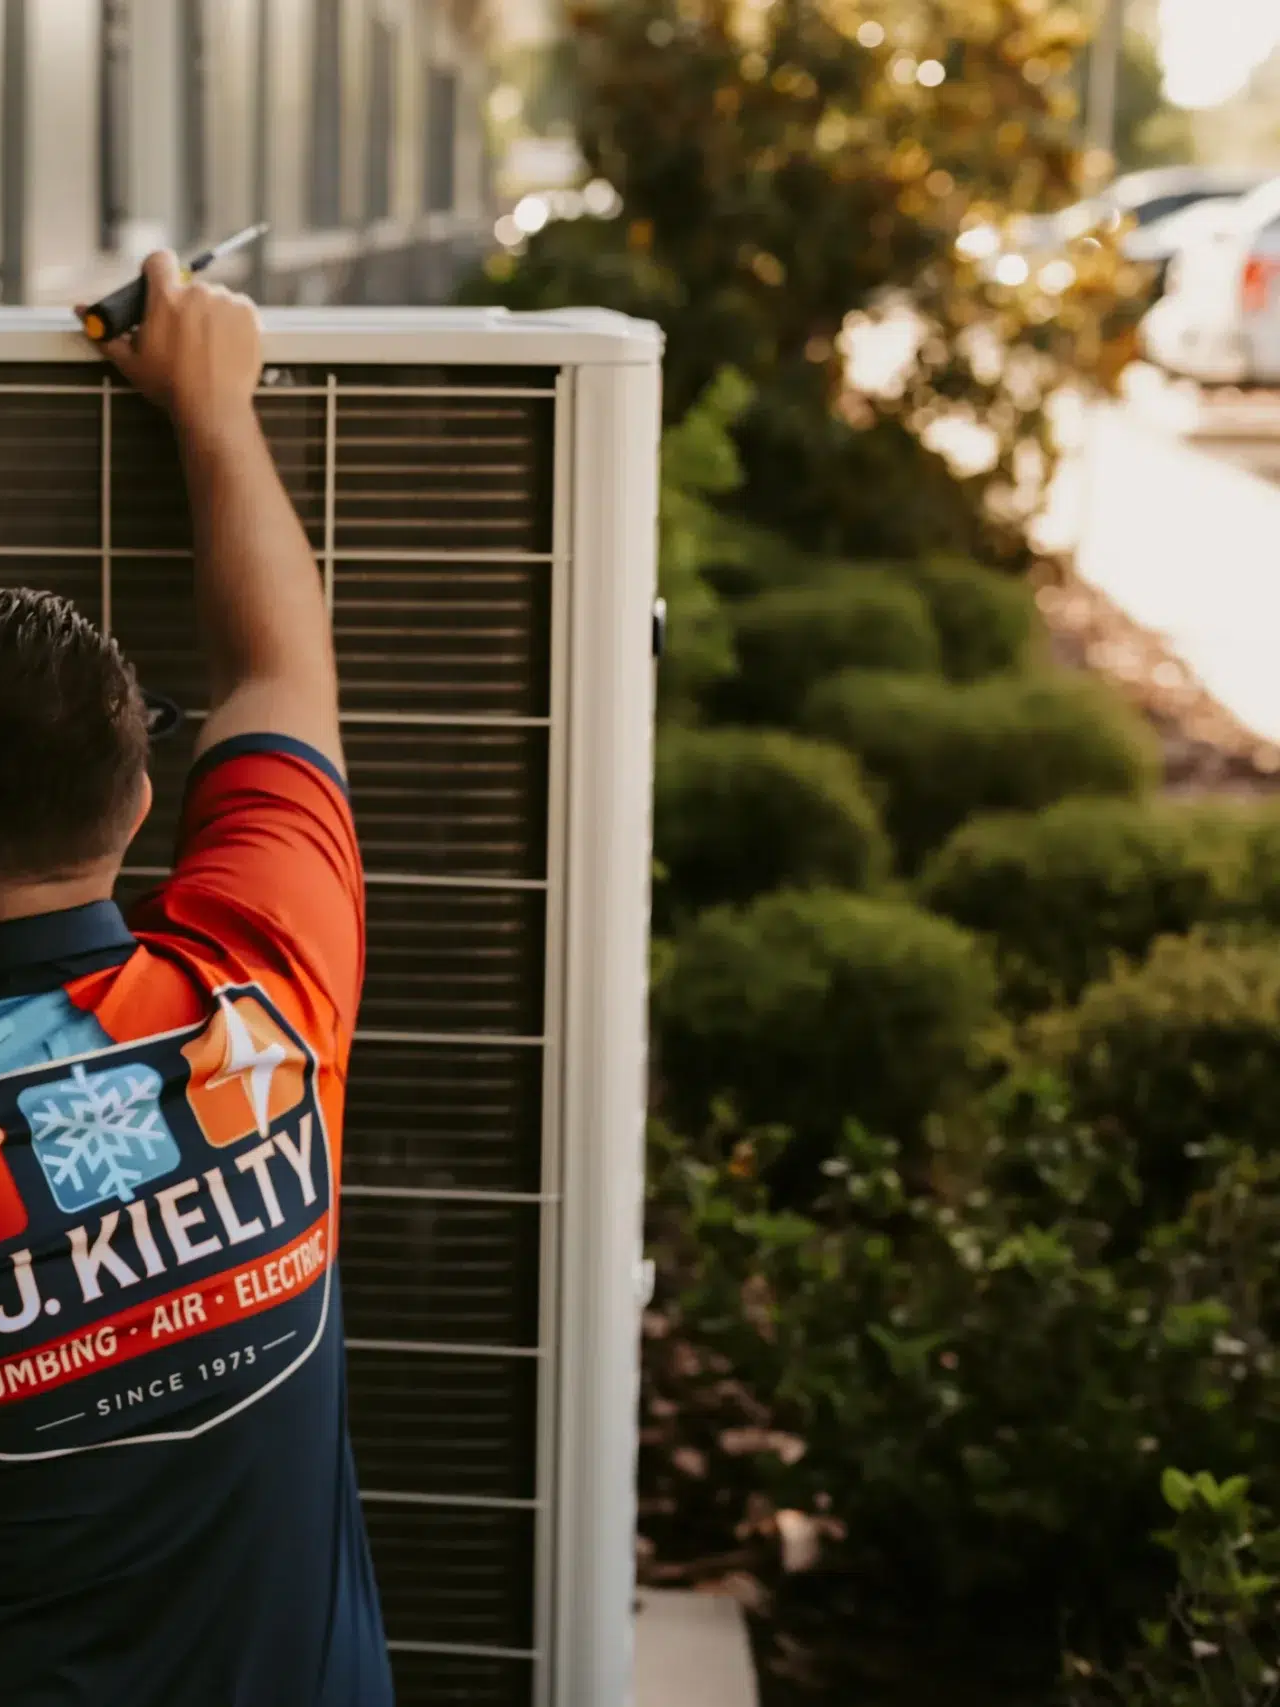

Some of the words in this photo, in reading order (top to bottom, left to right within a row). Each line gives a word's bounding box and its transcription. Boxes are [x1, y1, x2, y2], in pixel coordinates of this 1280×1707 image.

[66, 1113, 318, 1303] KIELTY
[151, 1292, 207, 1338] AIR
[234, 1229, 324, 1308] ELECTRIC
[97, 1372, 184, 1416] SINCE
[198, 1346, 257, 1381] 1973
